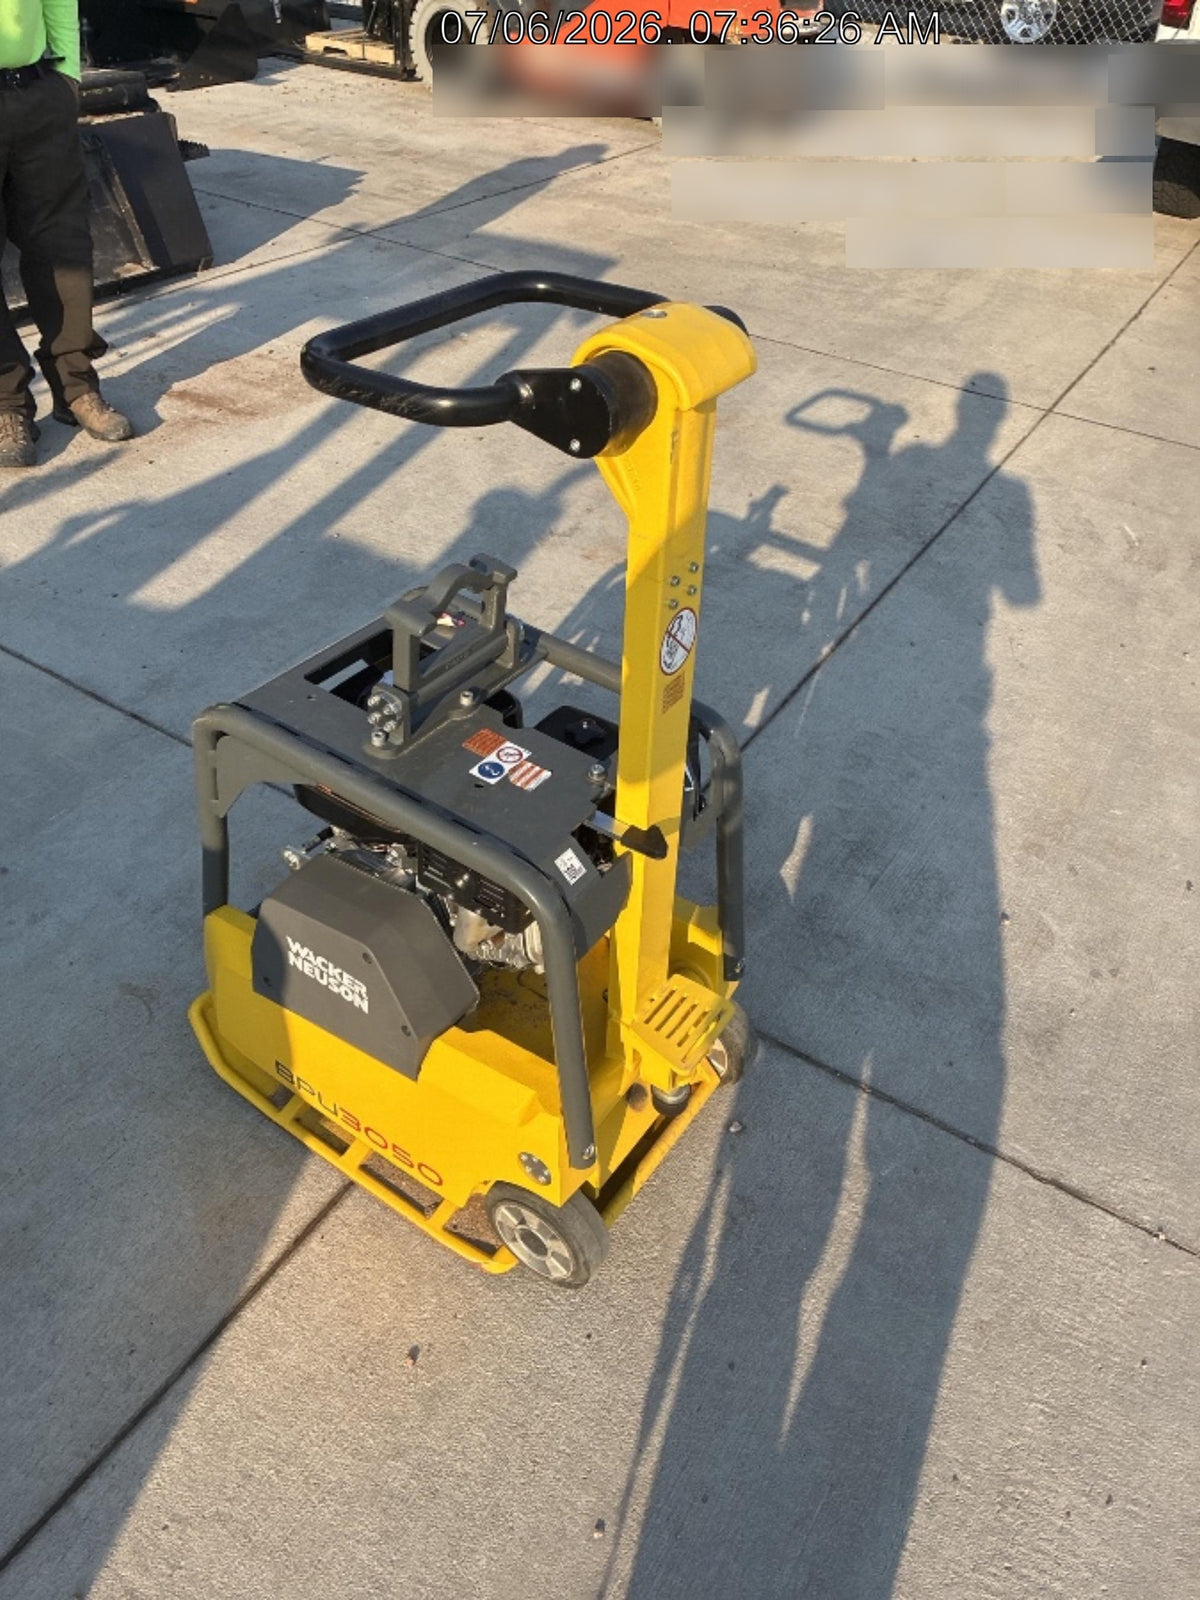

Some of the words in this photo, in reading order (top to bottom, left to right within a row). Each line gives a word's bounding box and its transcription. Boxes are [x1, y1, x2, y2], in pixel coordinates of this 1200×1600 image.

[286, 935, 369, 1000] WACKER
[288, 950, 369, 1014] NEUSON
[275, 1059, 443, 1187] BPU3050
